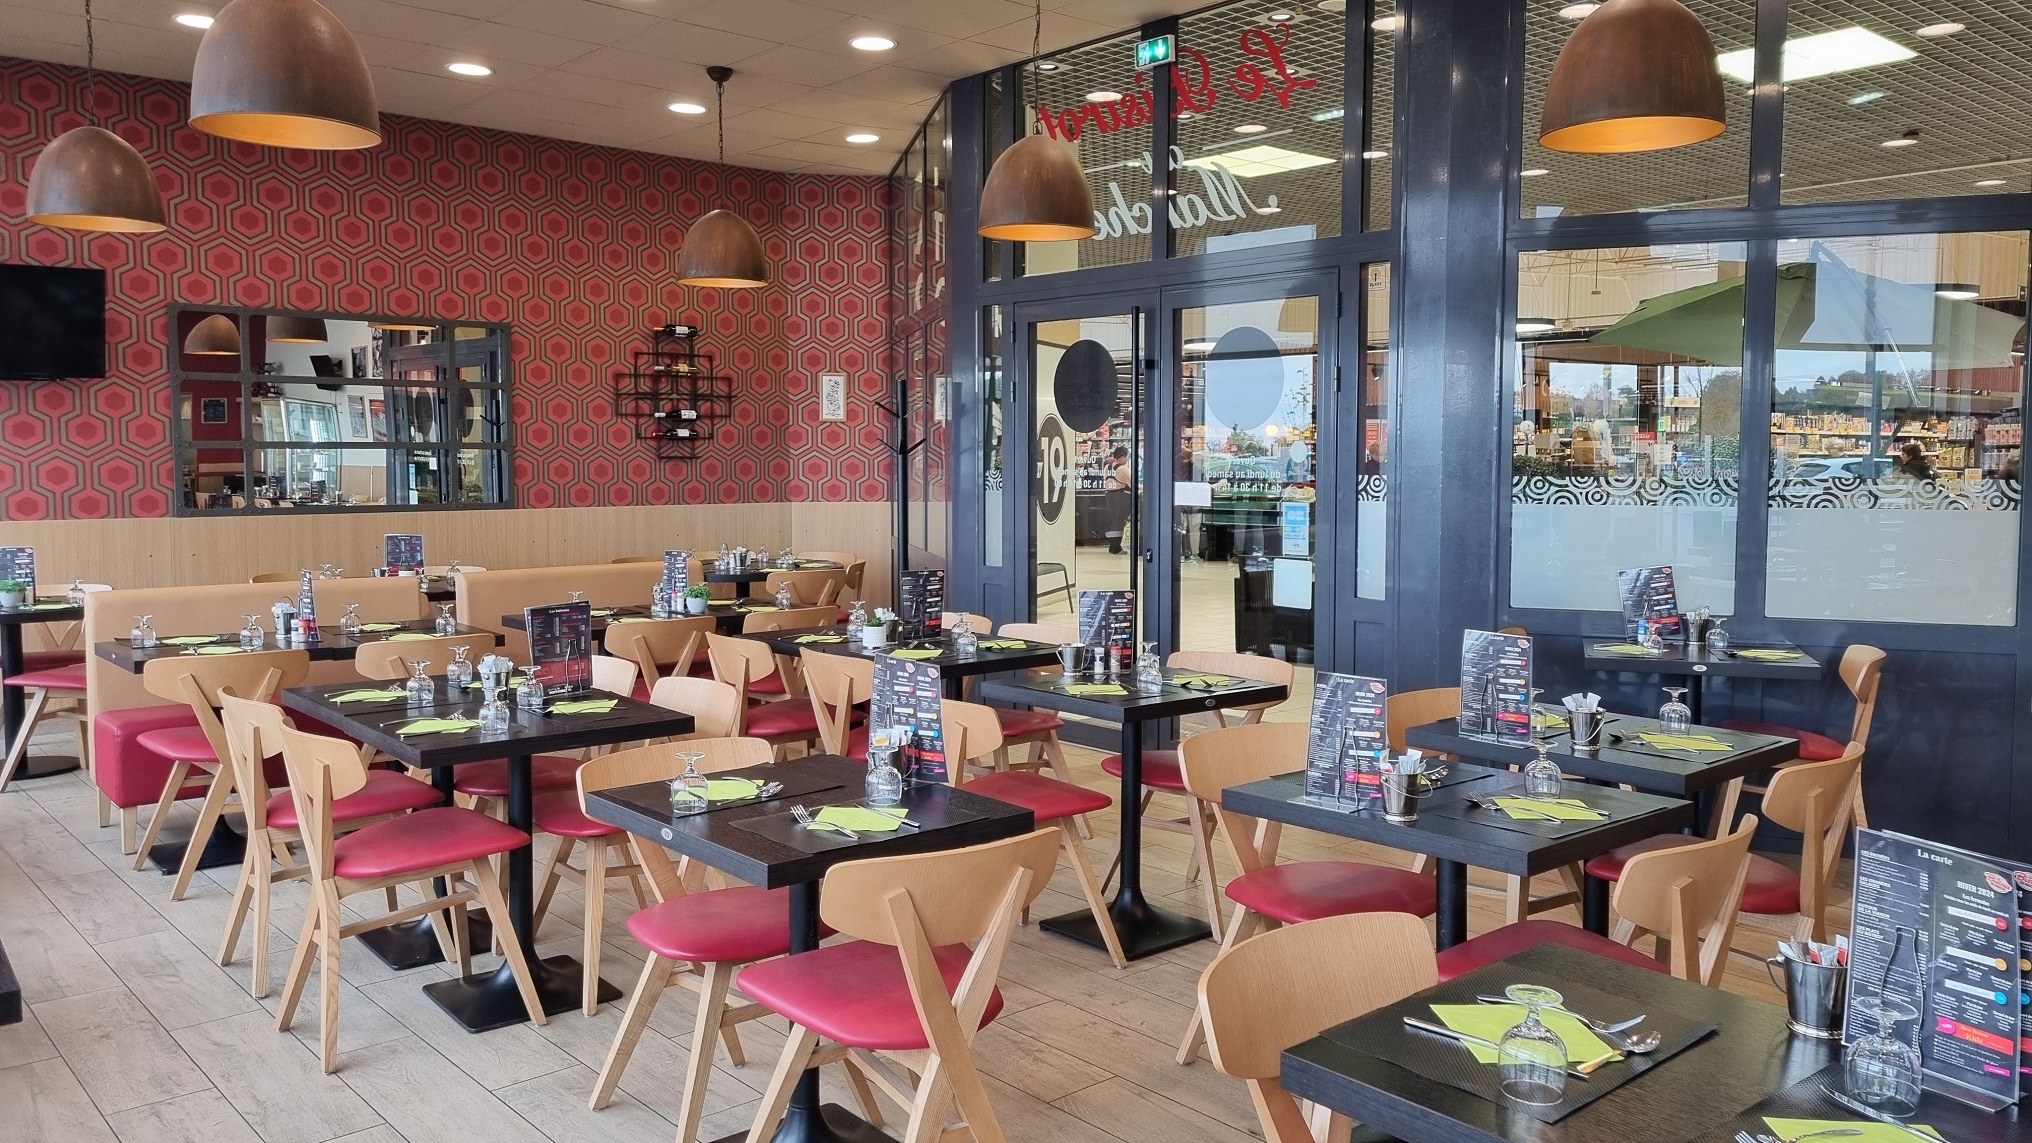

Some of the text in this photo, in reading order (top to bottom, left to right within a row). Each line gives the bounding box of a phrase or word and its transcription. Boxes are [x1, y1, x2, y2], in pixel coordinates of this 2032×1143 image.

[1917, 848, 1953, 866] La carte
[1956, 881, 1995, 899] HIVER 2024
